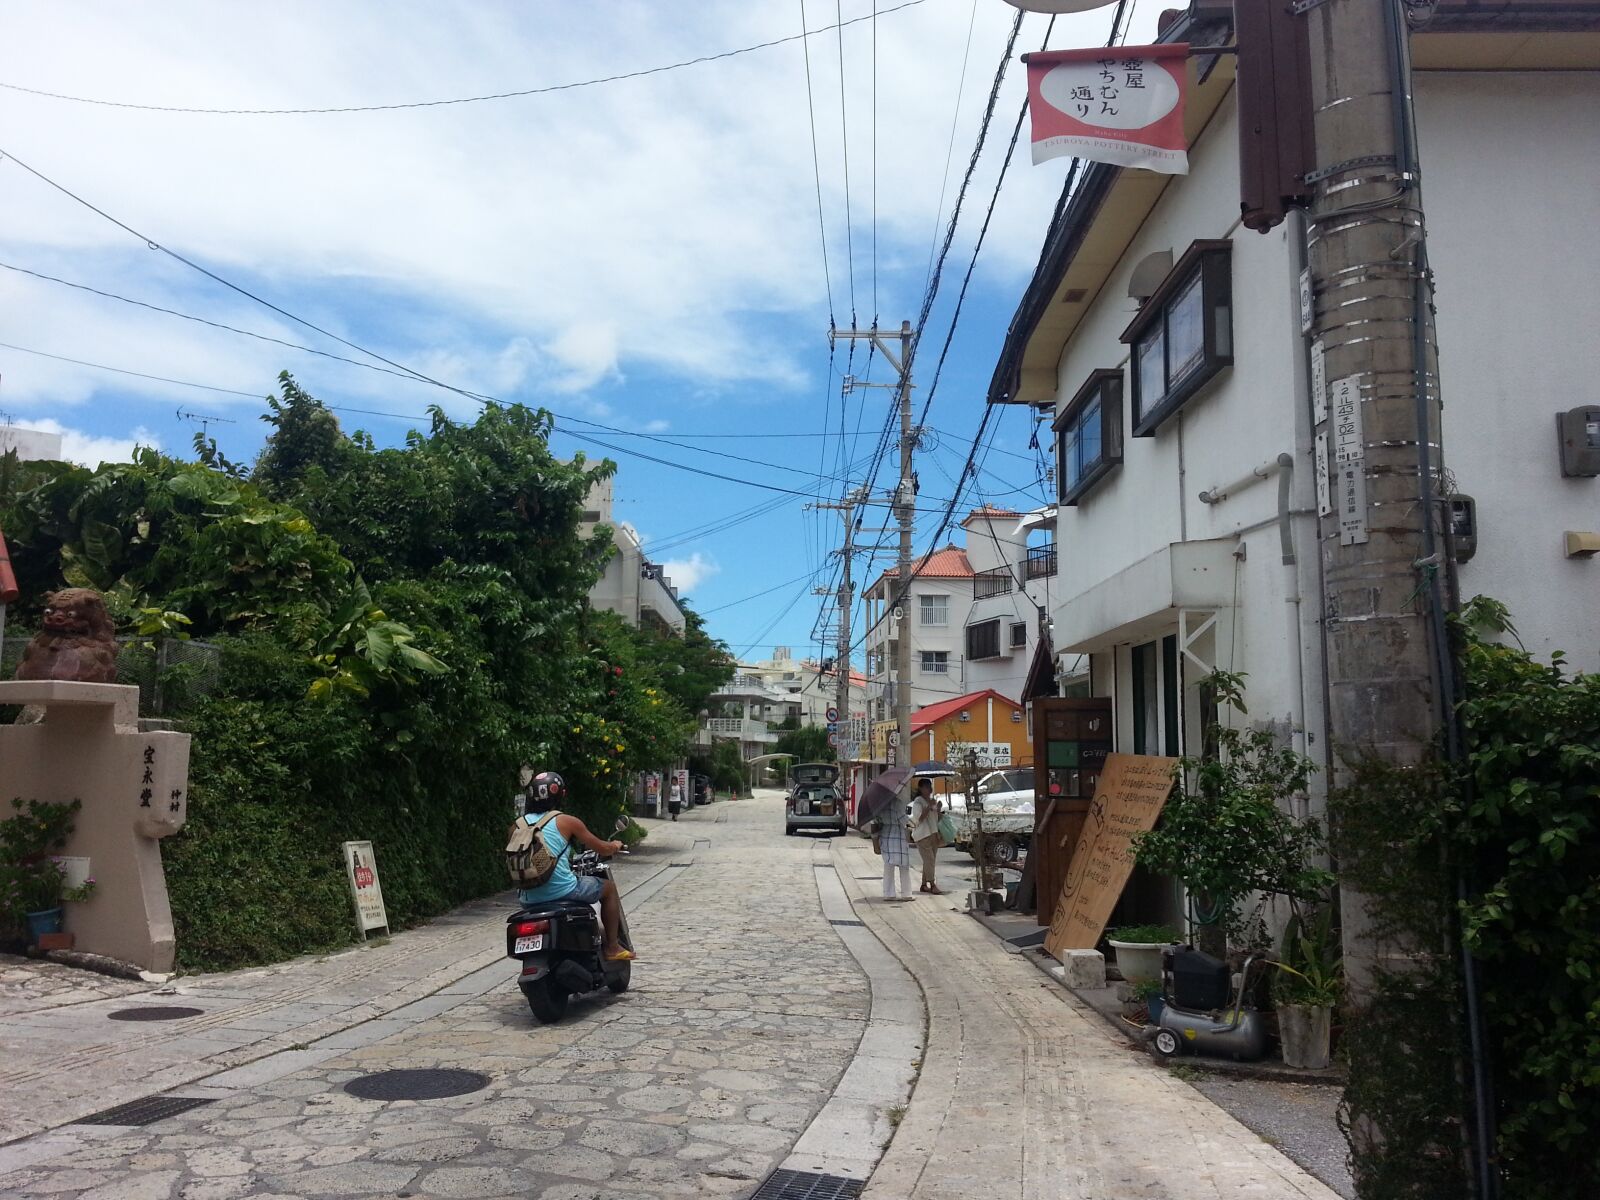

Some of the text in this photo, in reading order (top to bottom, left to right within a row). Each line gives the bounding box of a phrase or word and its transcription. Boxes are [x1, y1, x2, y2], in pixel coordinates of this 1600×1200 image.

[1097, 58, 1119, 116] やちむん
[1121, 57, 1145, 89] 壺屋
[1071, 86, 1094, 118] 通り
[1094, 141, 1138, 153] POTTERY
[1142, 145, 1176, 160] STREET
[140, 745, 155, 808] 宝永堂
